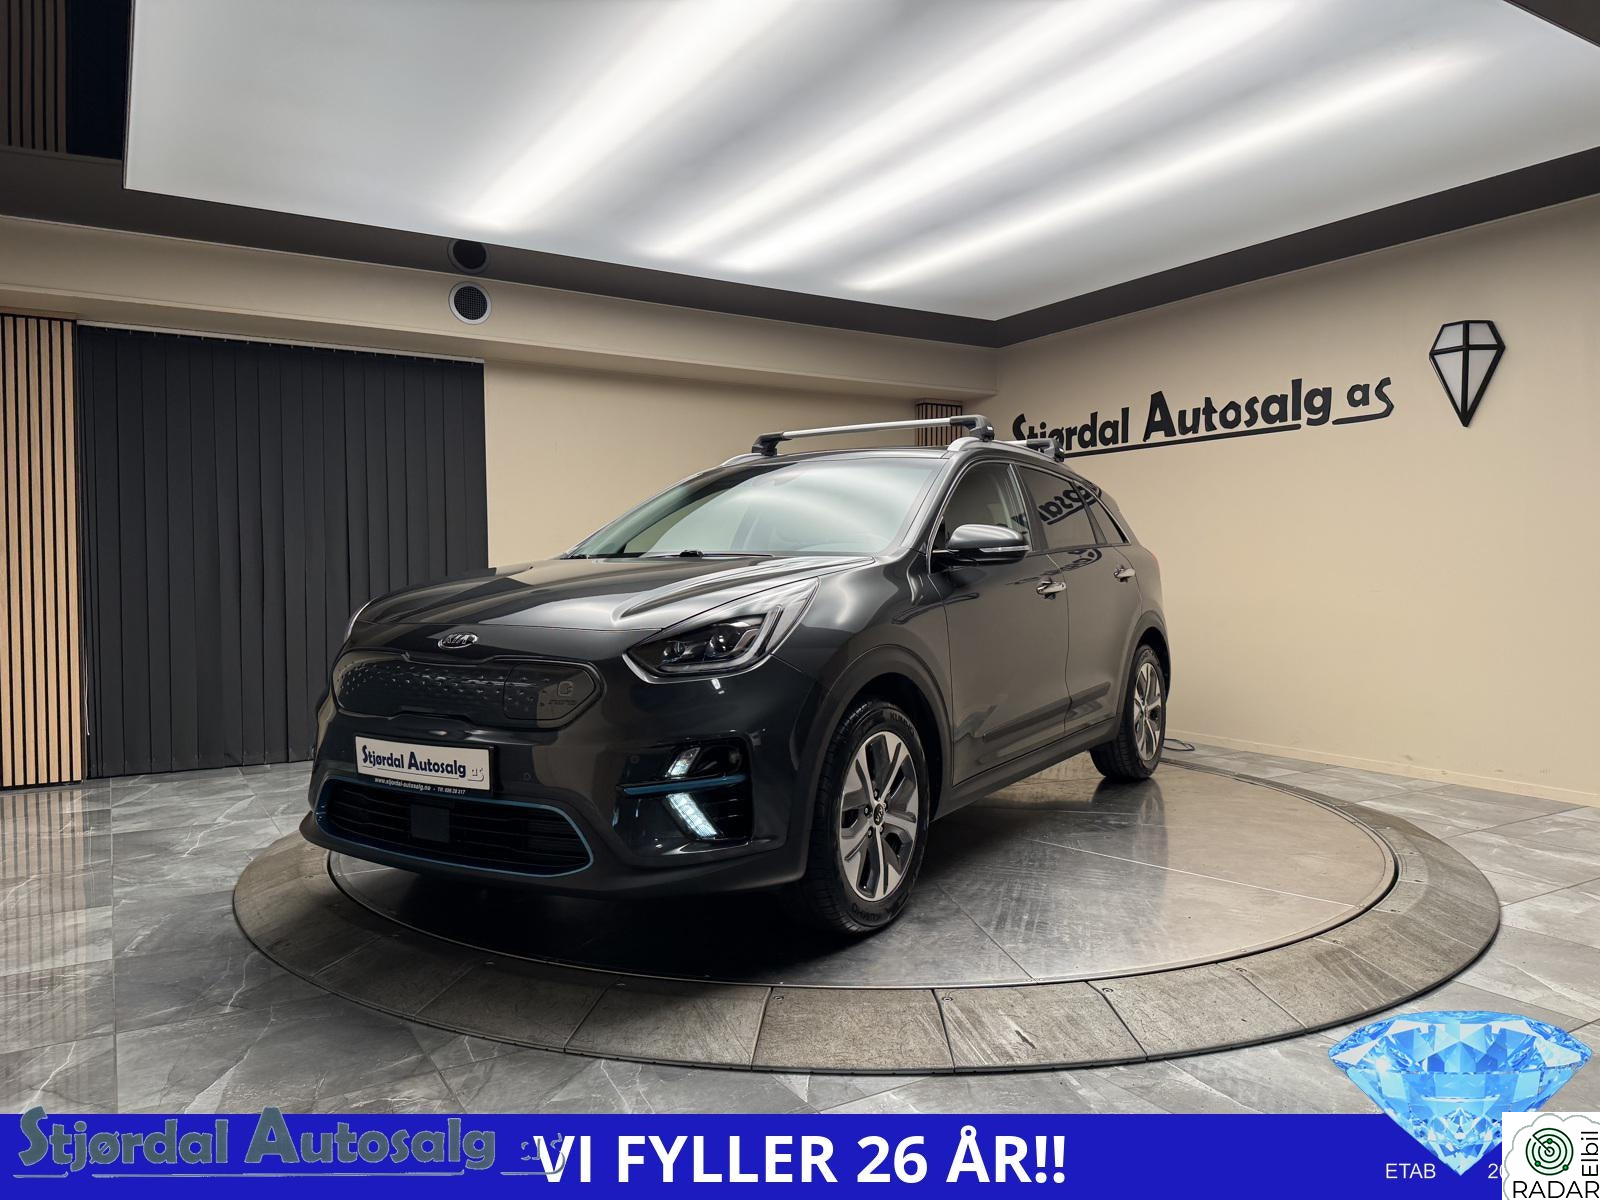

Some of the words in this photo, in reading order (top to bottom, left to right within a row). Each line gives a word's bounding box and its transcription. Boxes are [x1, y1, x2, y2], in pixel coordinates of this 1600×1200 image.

[1143, 378, 1333, 442] Autosalg
[1334, 377, 1395, 425] as
[362, 744, 405, 769] Stjørdal
[407, 751, 466, 778] Autosalg
